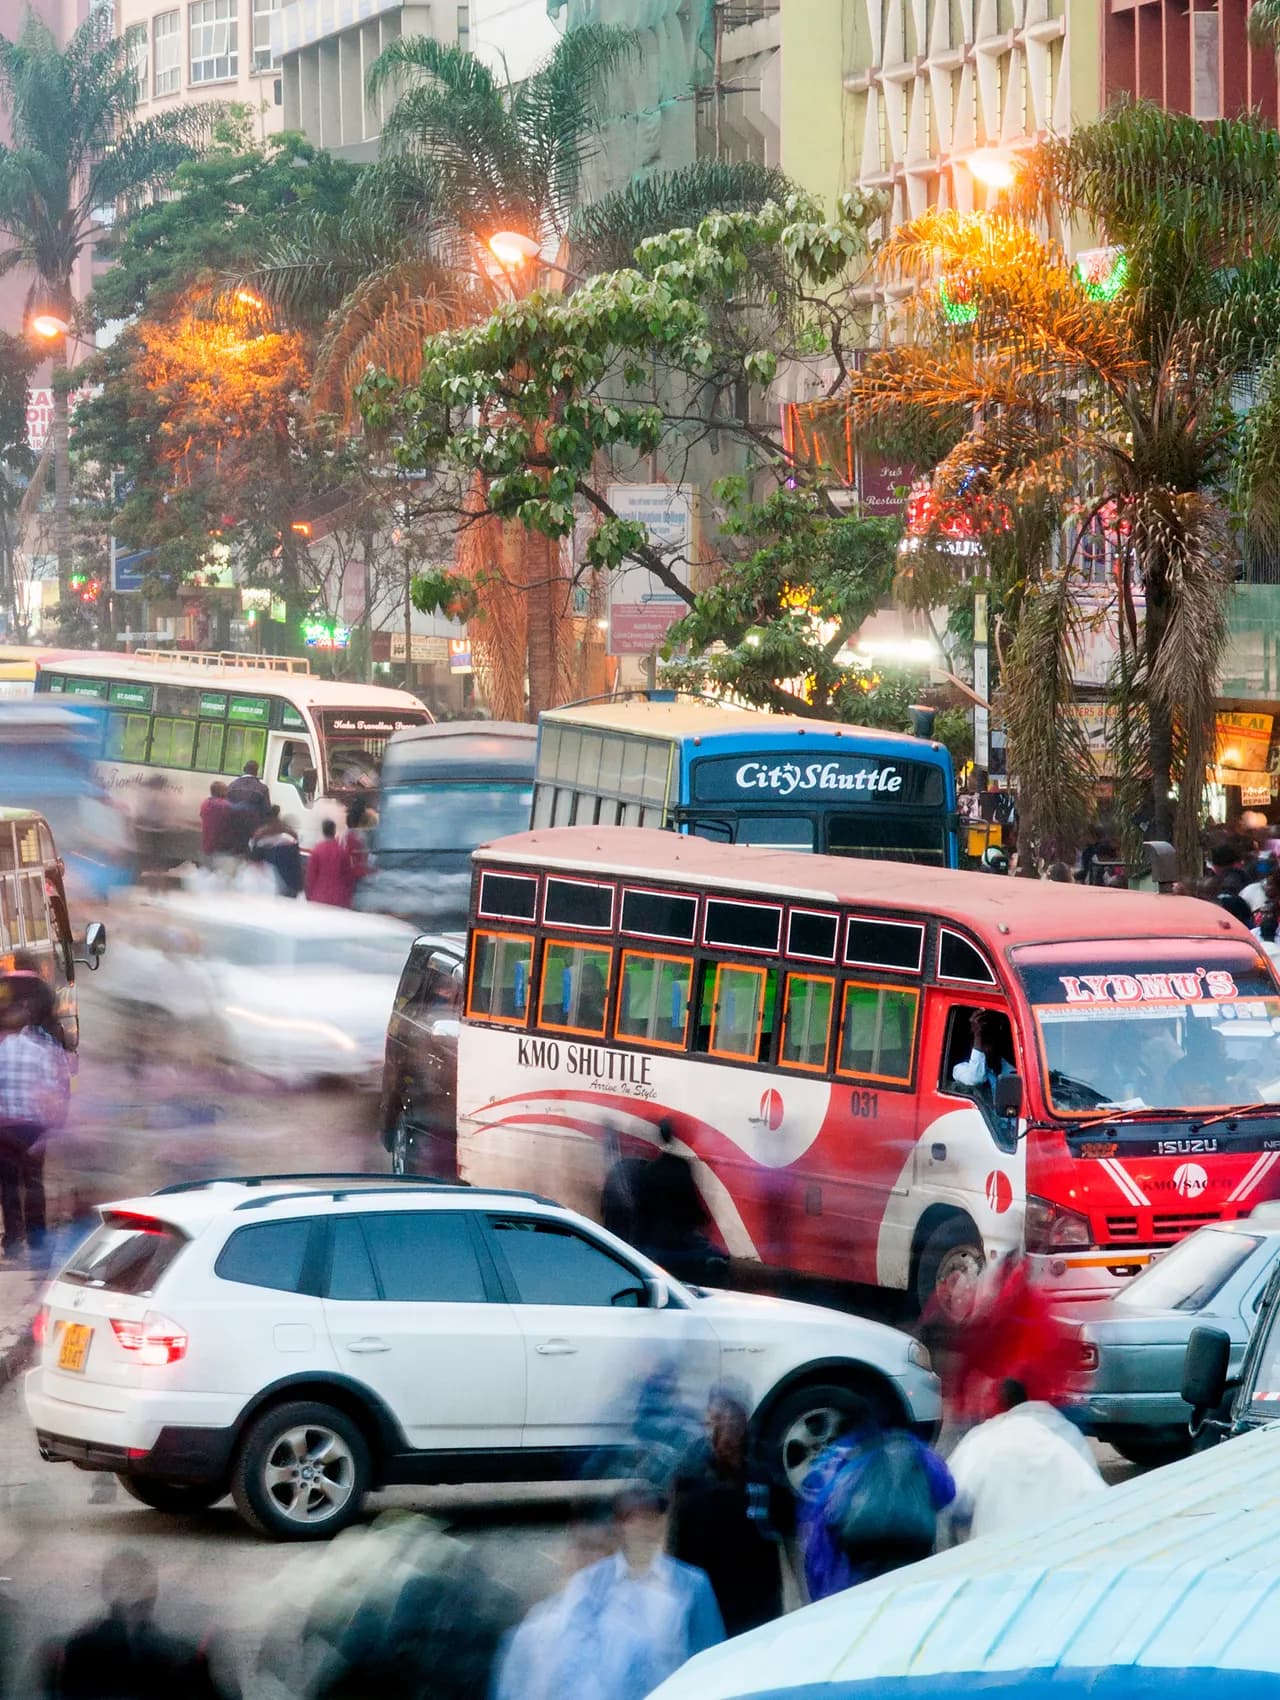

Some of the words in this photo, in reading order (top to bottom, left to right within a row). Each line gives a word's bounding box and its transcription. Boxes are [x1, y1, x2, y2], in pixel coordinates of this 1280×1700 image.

[1058, 967, 1239, 1004] LYDMU'S
[517, 1038, 560, 1071] KMO
[566, 1044, 653, 1086] SHUTTLE
[632, 1085, 658, 1100] Style
[851, 1090, 879, 1119] 031
[1157, 1139, 1218, 1155] ISUZU
[1142, 1180, 1177, 1191] KMO
